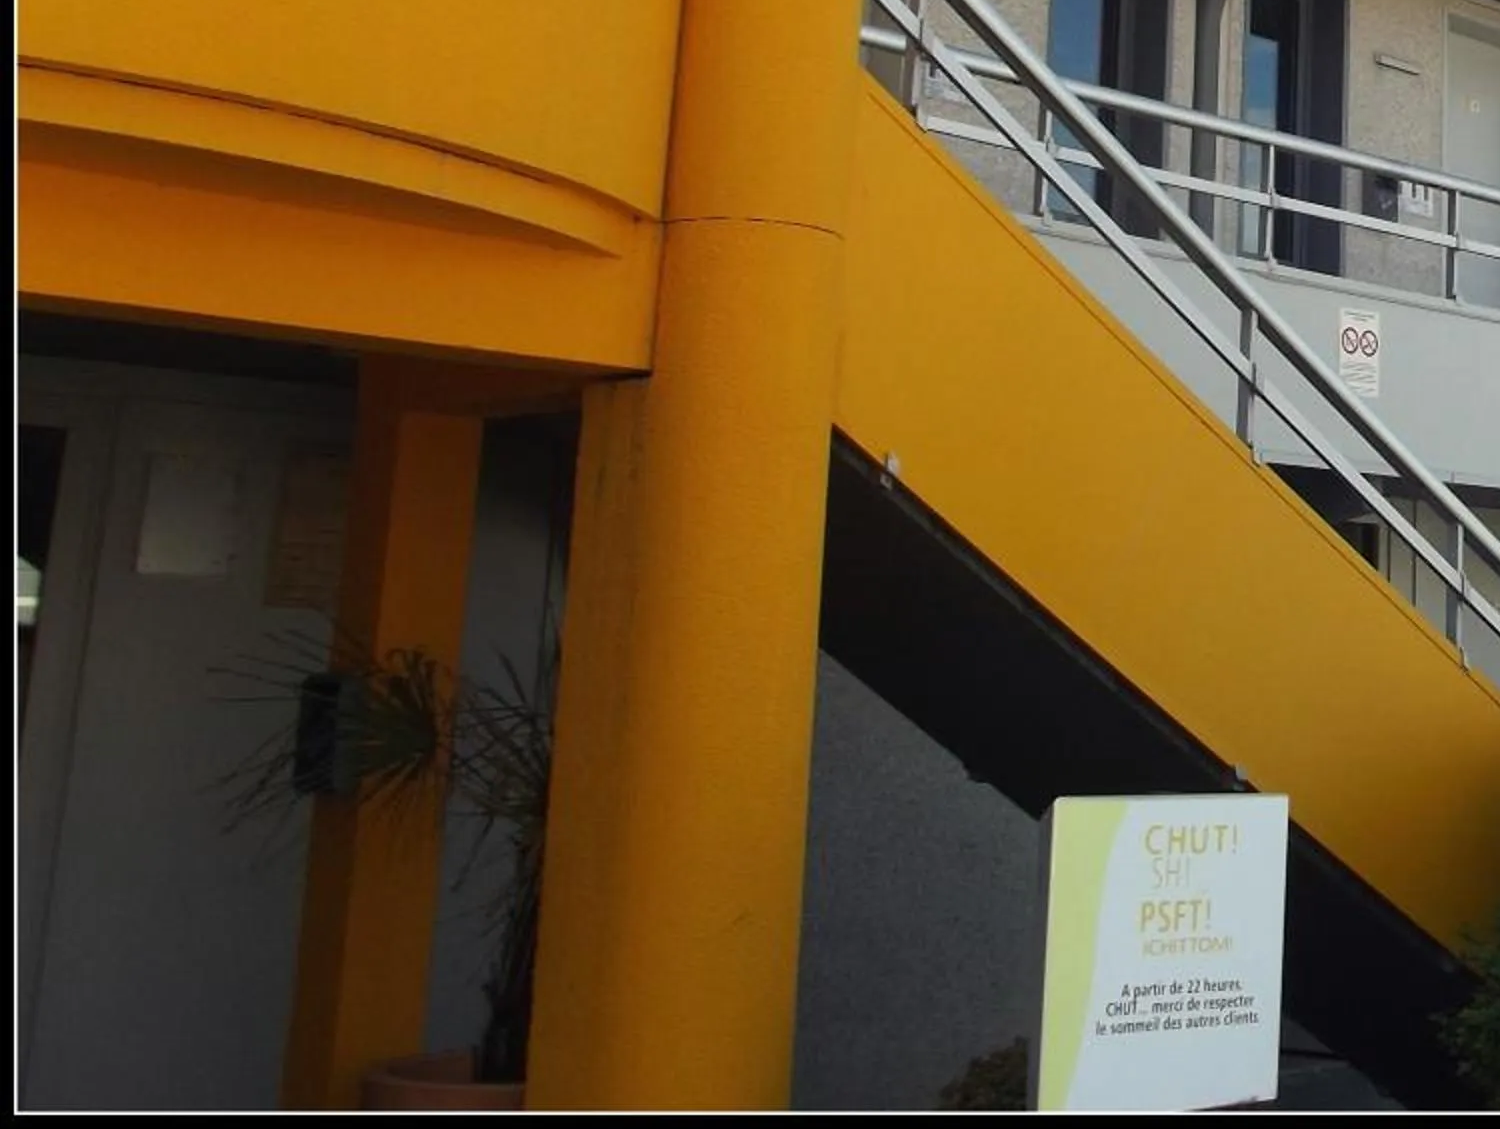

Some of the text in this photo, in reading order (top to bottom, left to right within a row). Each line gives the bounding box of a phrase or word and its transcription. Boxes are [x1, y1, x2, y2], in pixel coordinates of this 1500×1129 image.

[1144, 823, 1238, 855] CHUT!
[1139, 898, 1211, 933] PSFT!
[1121, 983, 1130, 998] A
[1134, 983, 1166, 1001] partir
[1170, 981, 1183, 995] de
[1187, 979, 1200, 994] 22
[1152, 1000, 1184, 1014] merci
[1187, 997, 1200, 1011] de
[1203, 995, 1255, 1012] respecter
[1096, 1020, 1107, 1036] le
[1111, 1018, 1160, 1034] sommeil
[1164, 1016, 1182, 1031] des
[1185, 1015, 1220, 1029] autres
